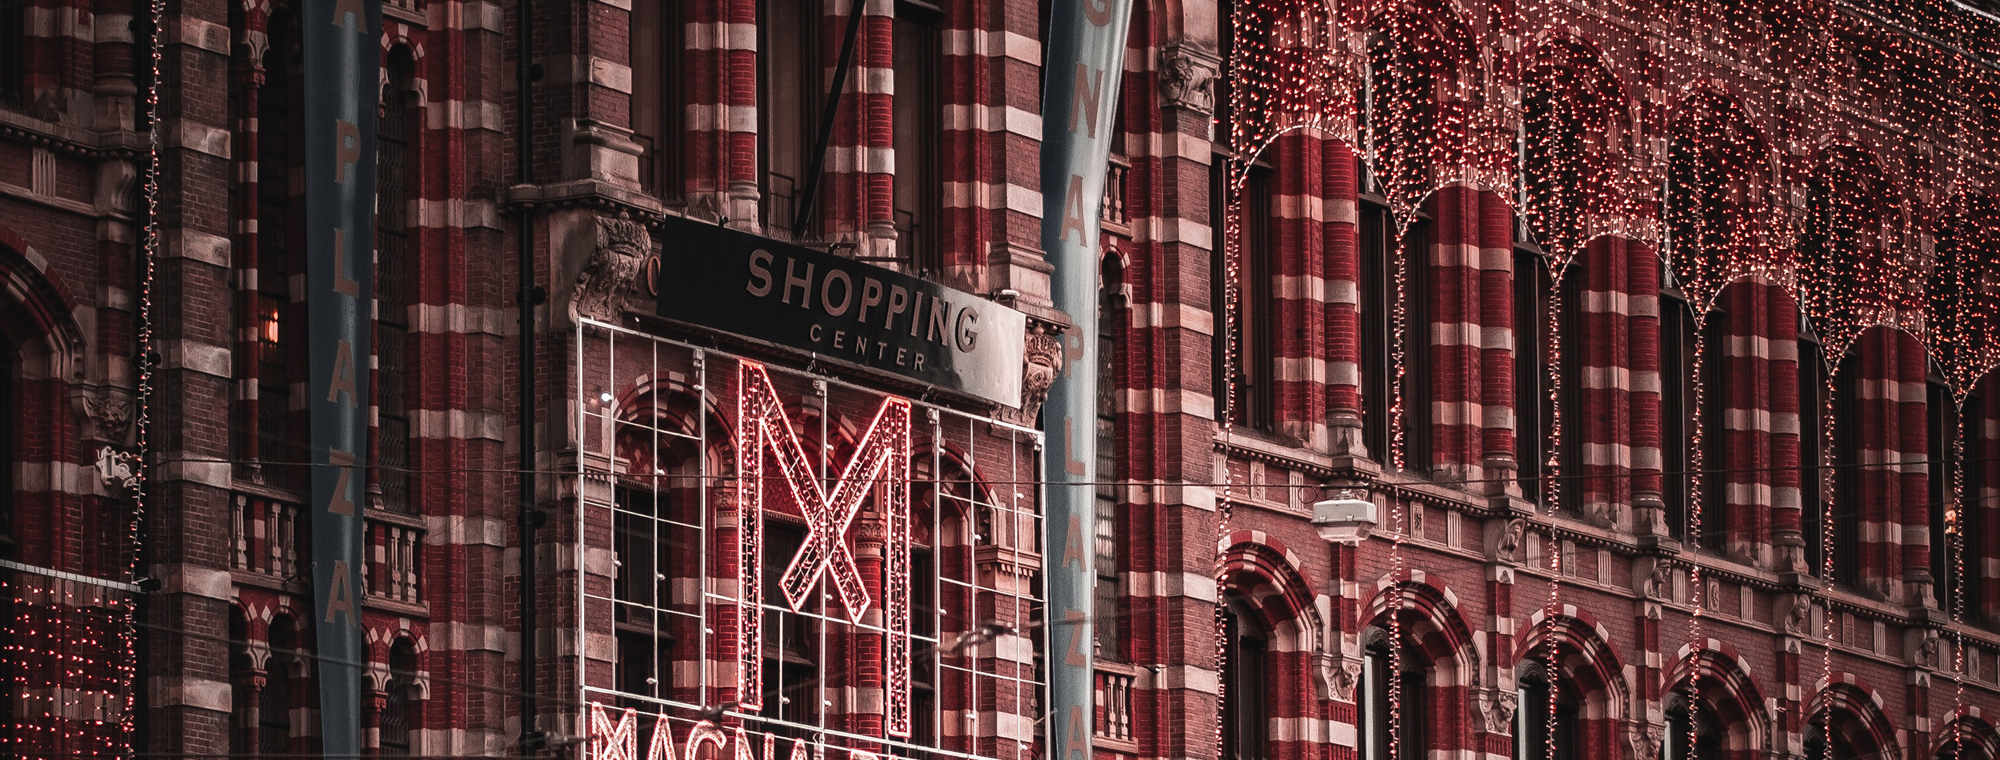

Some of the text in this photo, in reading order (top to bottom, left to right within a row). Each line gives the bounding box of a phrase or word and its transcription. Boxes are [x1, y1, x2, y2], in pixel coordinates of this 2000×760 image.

[325, 119, 361, 627] PLAZA
[746, 249, 979, 353] SHOPPING
[810, 324, 925, 372] CENTER
[1061, 323, 1088, 760] PLAZA
